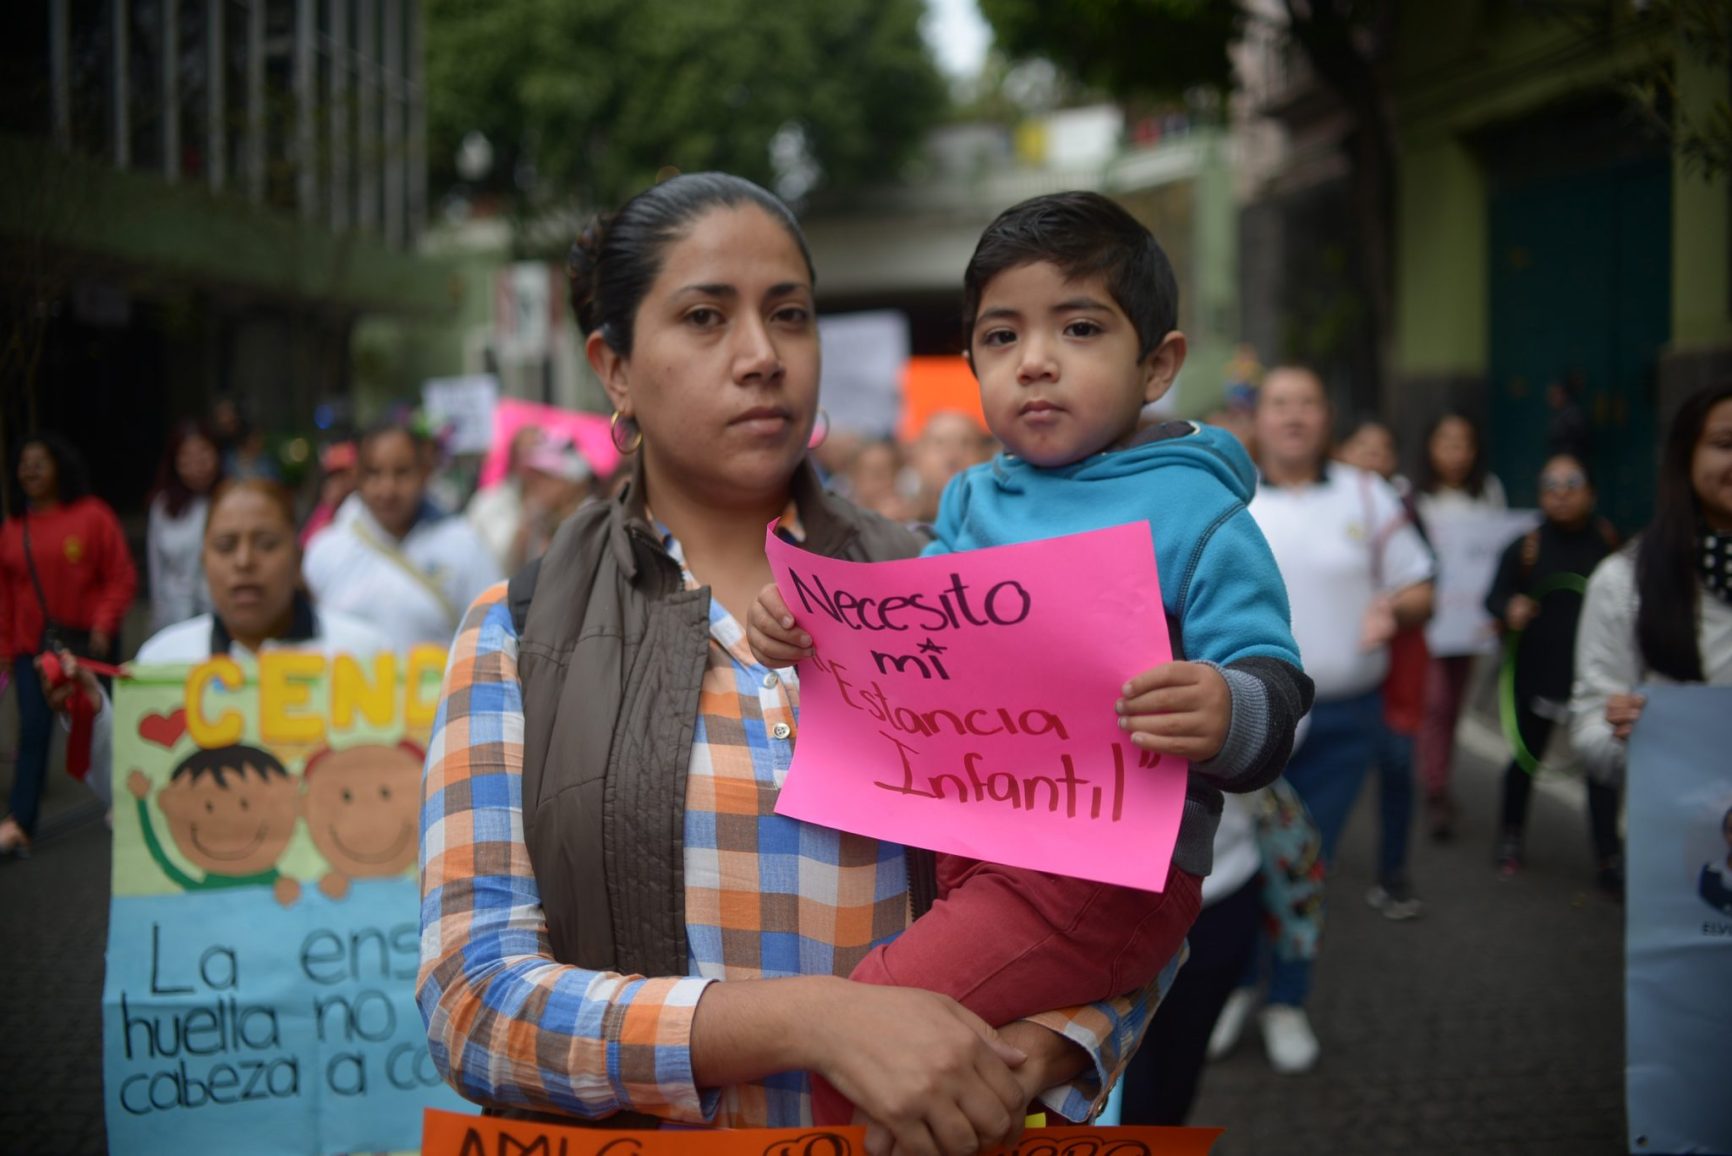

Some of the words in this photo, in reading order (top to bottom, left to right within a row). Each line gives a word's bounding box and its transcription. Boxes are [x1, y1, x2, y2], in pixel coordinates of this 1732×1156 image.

[788, 566, 1032, 632] Necesito
[871, 638, 951, 681] mi
[150, 922, 239, 998] La
[120, 989, 281, 1060] huella
[314, 989, 397, 1043] no
[119, 1052, 301, 1116] cabeza
[325, 1052, 368, 1097] a
